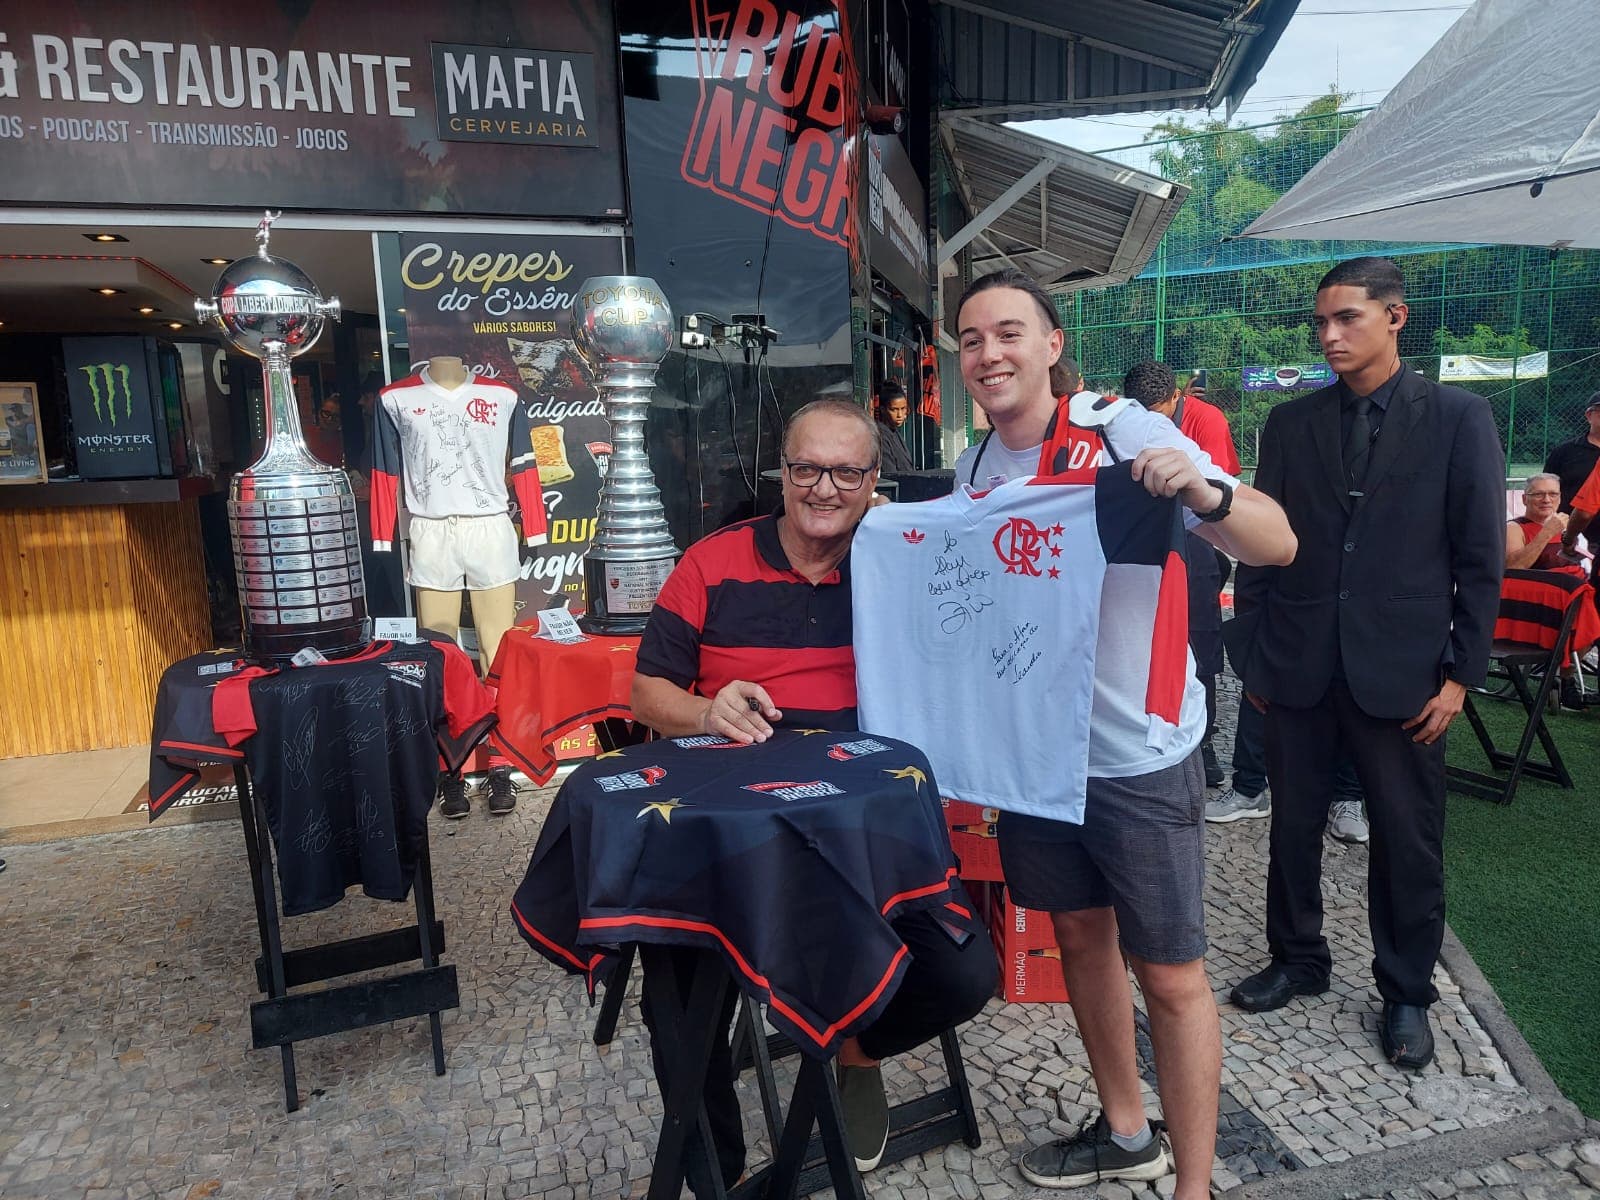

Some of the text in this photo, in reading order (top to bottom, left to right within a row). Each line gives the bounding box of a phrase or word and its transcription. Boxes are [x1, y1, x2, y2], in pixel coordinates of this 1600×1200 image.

[32, 34, 416, 117] RESTAURANTE
[443, 52, 585, 121] MAFIA
[42, 117, 129, 143] PODCAST
[147, 121, 278, 149] TRANSMISSÃO
[296, 128, 348, 151] JOGOS
[450, 118, 587, 137] CERVEJARIA
[401, 242, 574, 294] Crepes
[222, 296, 240, 314] COPA
[437, 286, 578, 316] do Essên
[582, 285, 664, 310] TOYOTA
[473, 319, 557, 334] VÁRIOS SABORES!
[602, 307, 647, 327] CUP
[521, 395, 606, 424] algad
[78, 434, 153, 447] MONSTER
[586, 733, 600, 747] 2
[1015, 951, 1027, 996] MERMÃO
